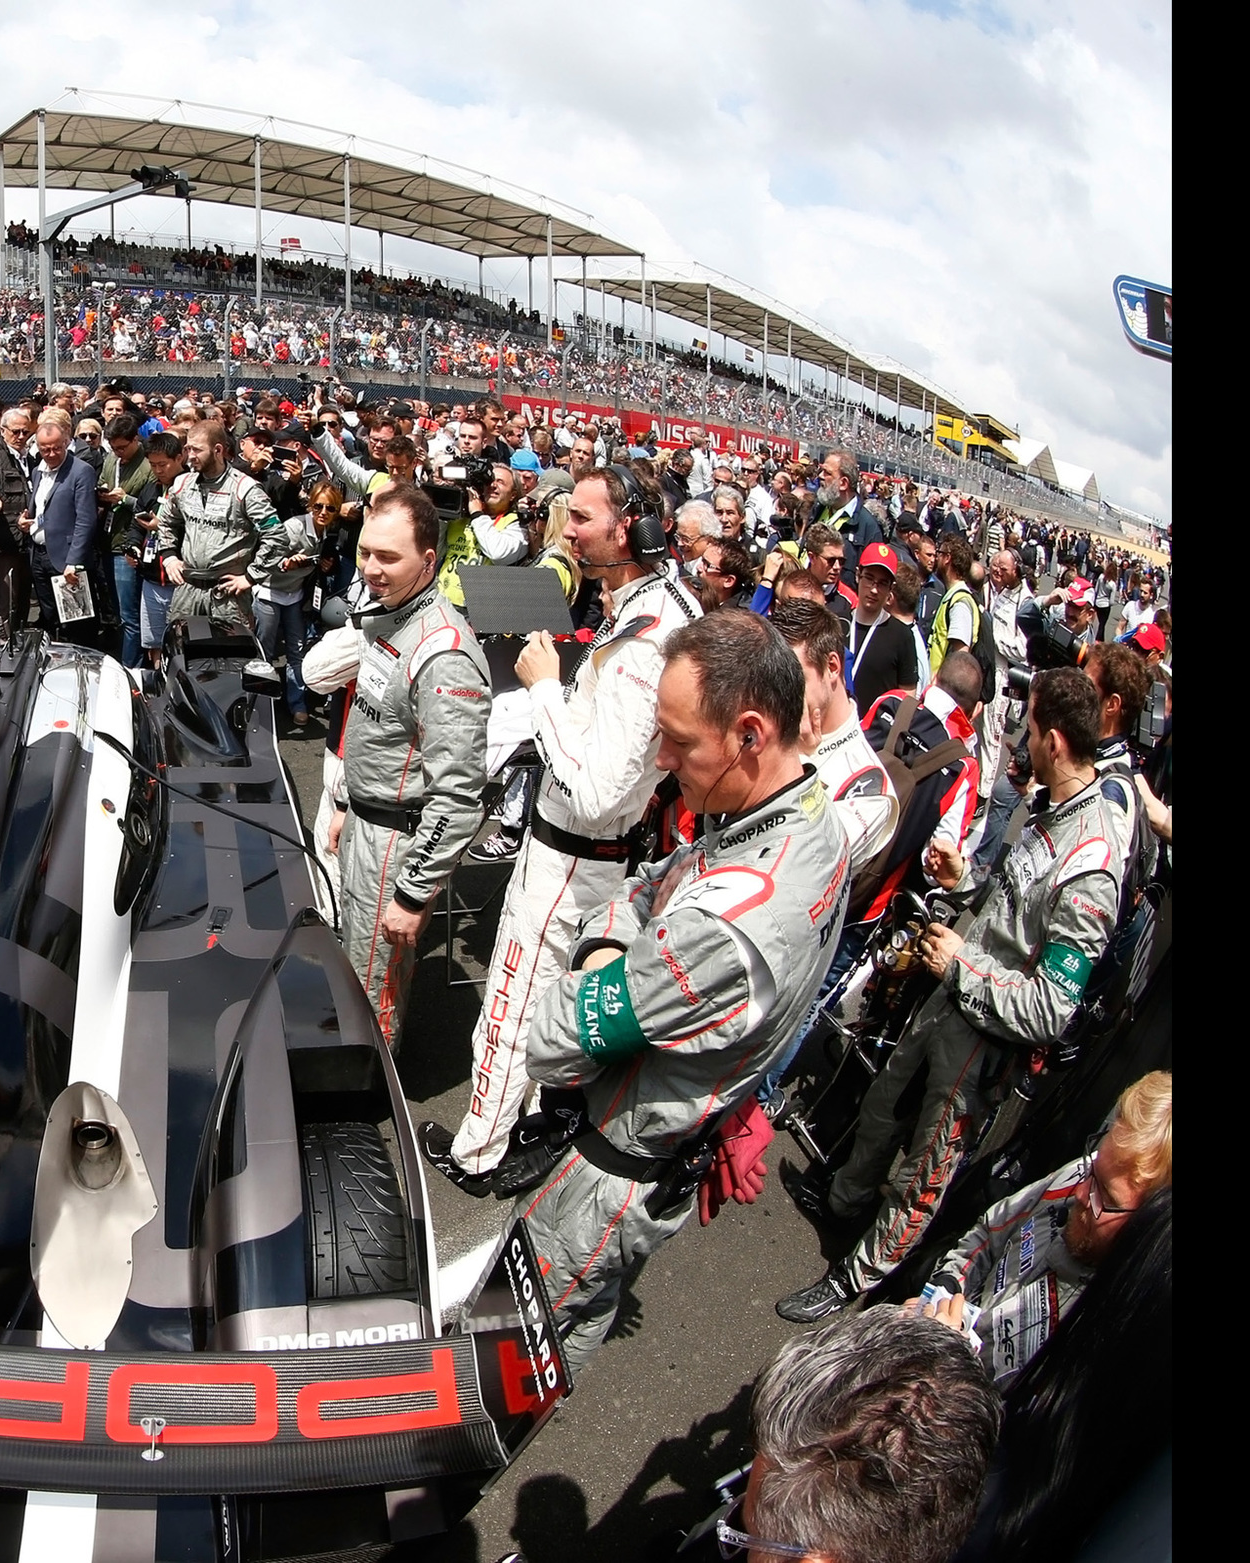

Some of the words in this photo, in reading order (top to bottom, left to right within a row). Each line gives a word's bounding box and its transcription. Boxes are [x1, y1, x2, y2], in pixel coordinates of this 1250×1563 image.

[651, 420, 721, 450] NISSN
[394, 597, 434, 625] CHOPARD
[447, 687, 483, 699] vodafone
[817, 728, 860, 757] CHOPARD
[1055, 795, 1097, 823] CHOPARD
[426, 815, 451, 853] MORI
[719, 813, 787, 851] CHOPARD
[660, 945, 701, 1006] vodafone
[471, 939, 523, 1118] PORSCHE
[503, 1256, 519, 1306] OFFICIAL
[516, 1306, 530, 1347] TIMING
[528, 1344, 545, 1403] PARTNER
[511, 1237, 558, 1390] CHOPARD
[255, 1332, 331, 1351] DMG
[335, 1321, 419, 1348] MORI
